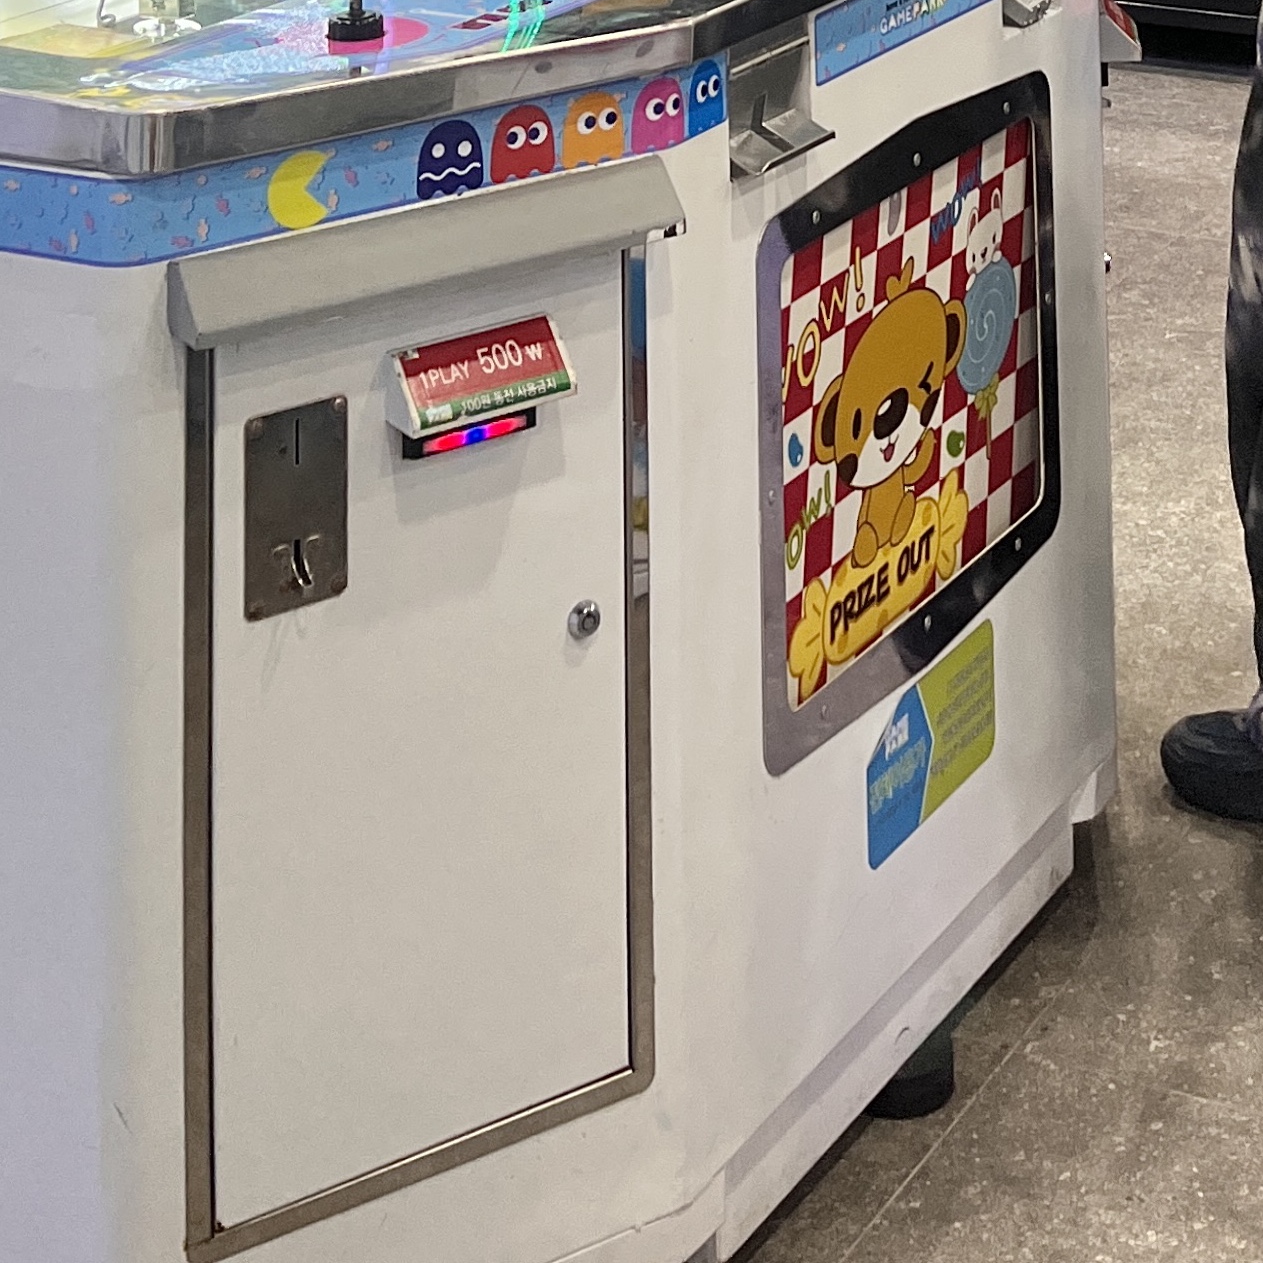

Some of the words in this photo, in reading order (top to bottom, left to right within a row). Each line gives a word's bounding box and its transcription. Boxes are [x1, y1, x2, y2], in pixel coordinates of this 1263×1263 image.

[475, 339, 523, 374] 500
[517, 376, 557, 398] 사용금지
[829, 562, 891, 645] PRIZE
[897, 524, 935, 587] OUT
